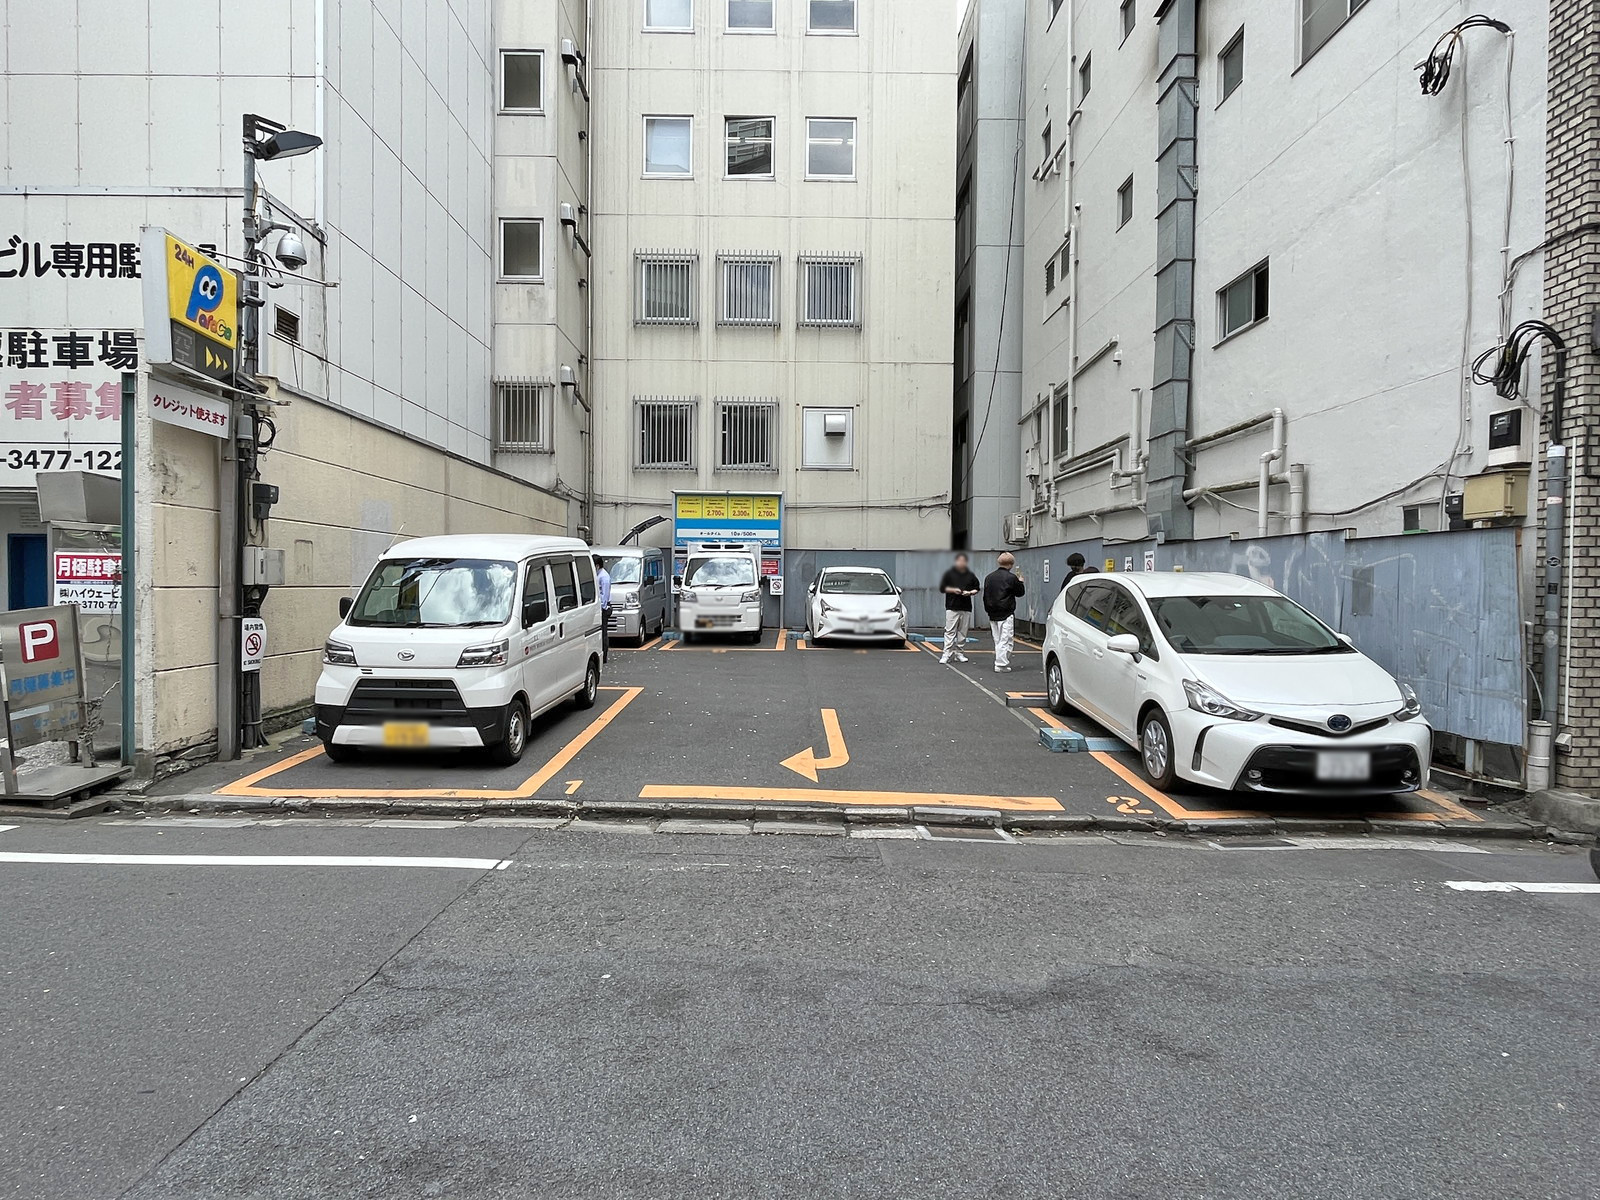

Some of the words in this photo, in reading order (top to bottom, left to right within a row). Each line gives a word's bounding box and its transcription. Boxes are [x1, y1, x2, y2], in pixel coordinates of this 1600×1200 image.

[175, 244, 195, 269] 24H
[0, 331, 138, 370] 駐車場
[153, 395, 228, 426] クレジット使えます
[58, 558, 122, 577] 月極駐車
[23, 622, 55, 661] P
[565, 780, 584, 795] 1
[1106, 796, 1154, 814] 2
